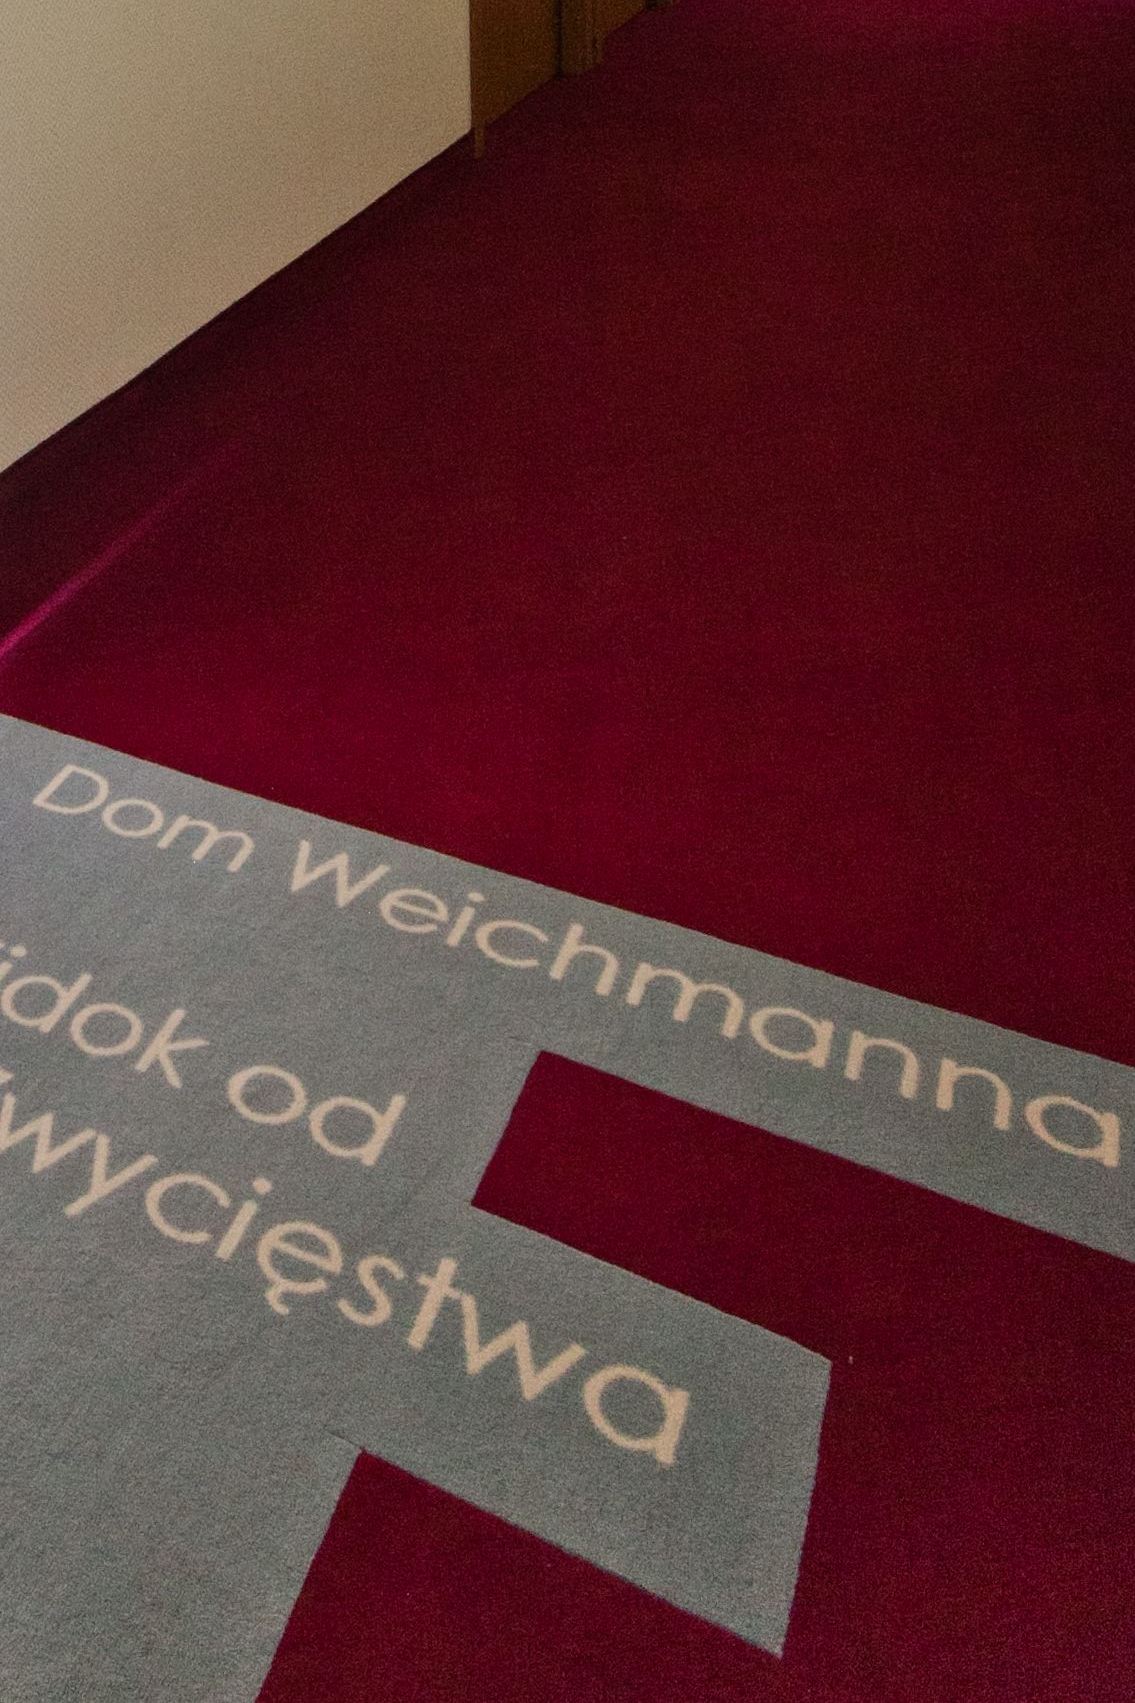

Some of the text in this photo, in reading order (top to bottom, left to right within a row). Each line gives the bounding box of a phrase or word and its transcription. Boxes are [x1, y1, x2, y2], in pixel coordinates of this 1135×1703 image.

[31, 763, 1122, 1168] Dom Weichmanna
[226, 1064, 408, 1167] od
